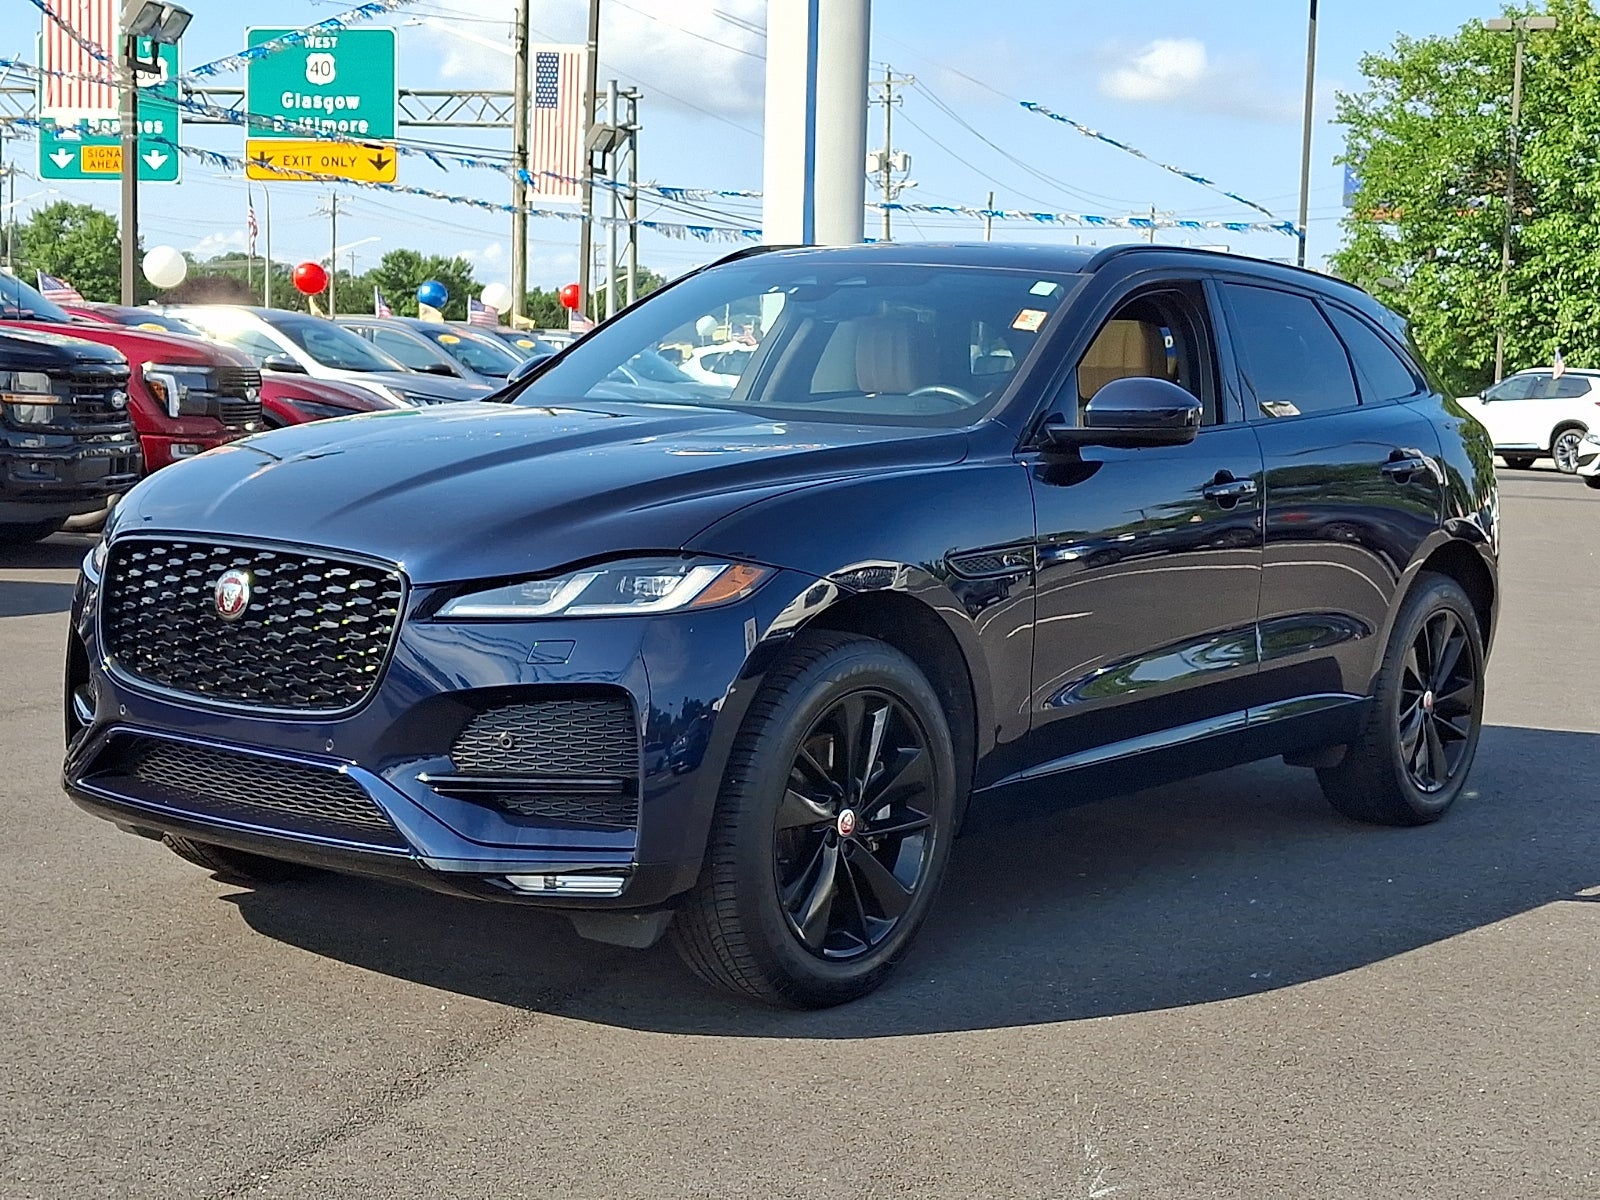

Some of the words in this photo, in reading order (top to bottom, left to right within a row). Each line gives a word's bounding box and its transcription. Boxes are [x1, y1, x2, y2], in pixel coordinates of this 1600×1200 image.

[303, 35, 339, 49] WEST
[310, 60, 331, 77] 40
[281, 91, 361, 115] Glasgow
[87, 149, 122, 159] SIGNA
[89, 160, 120, 170] AHEA
[283, 155, 313, 167] EXIT
[321, 156, 358, 168] ONLY
